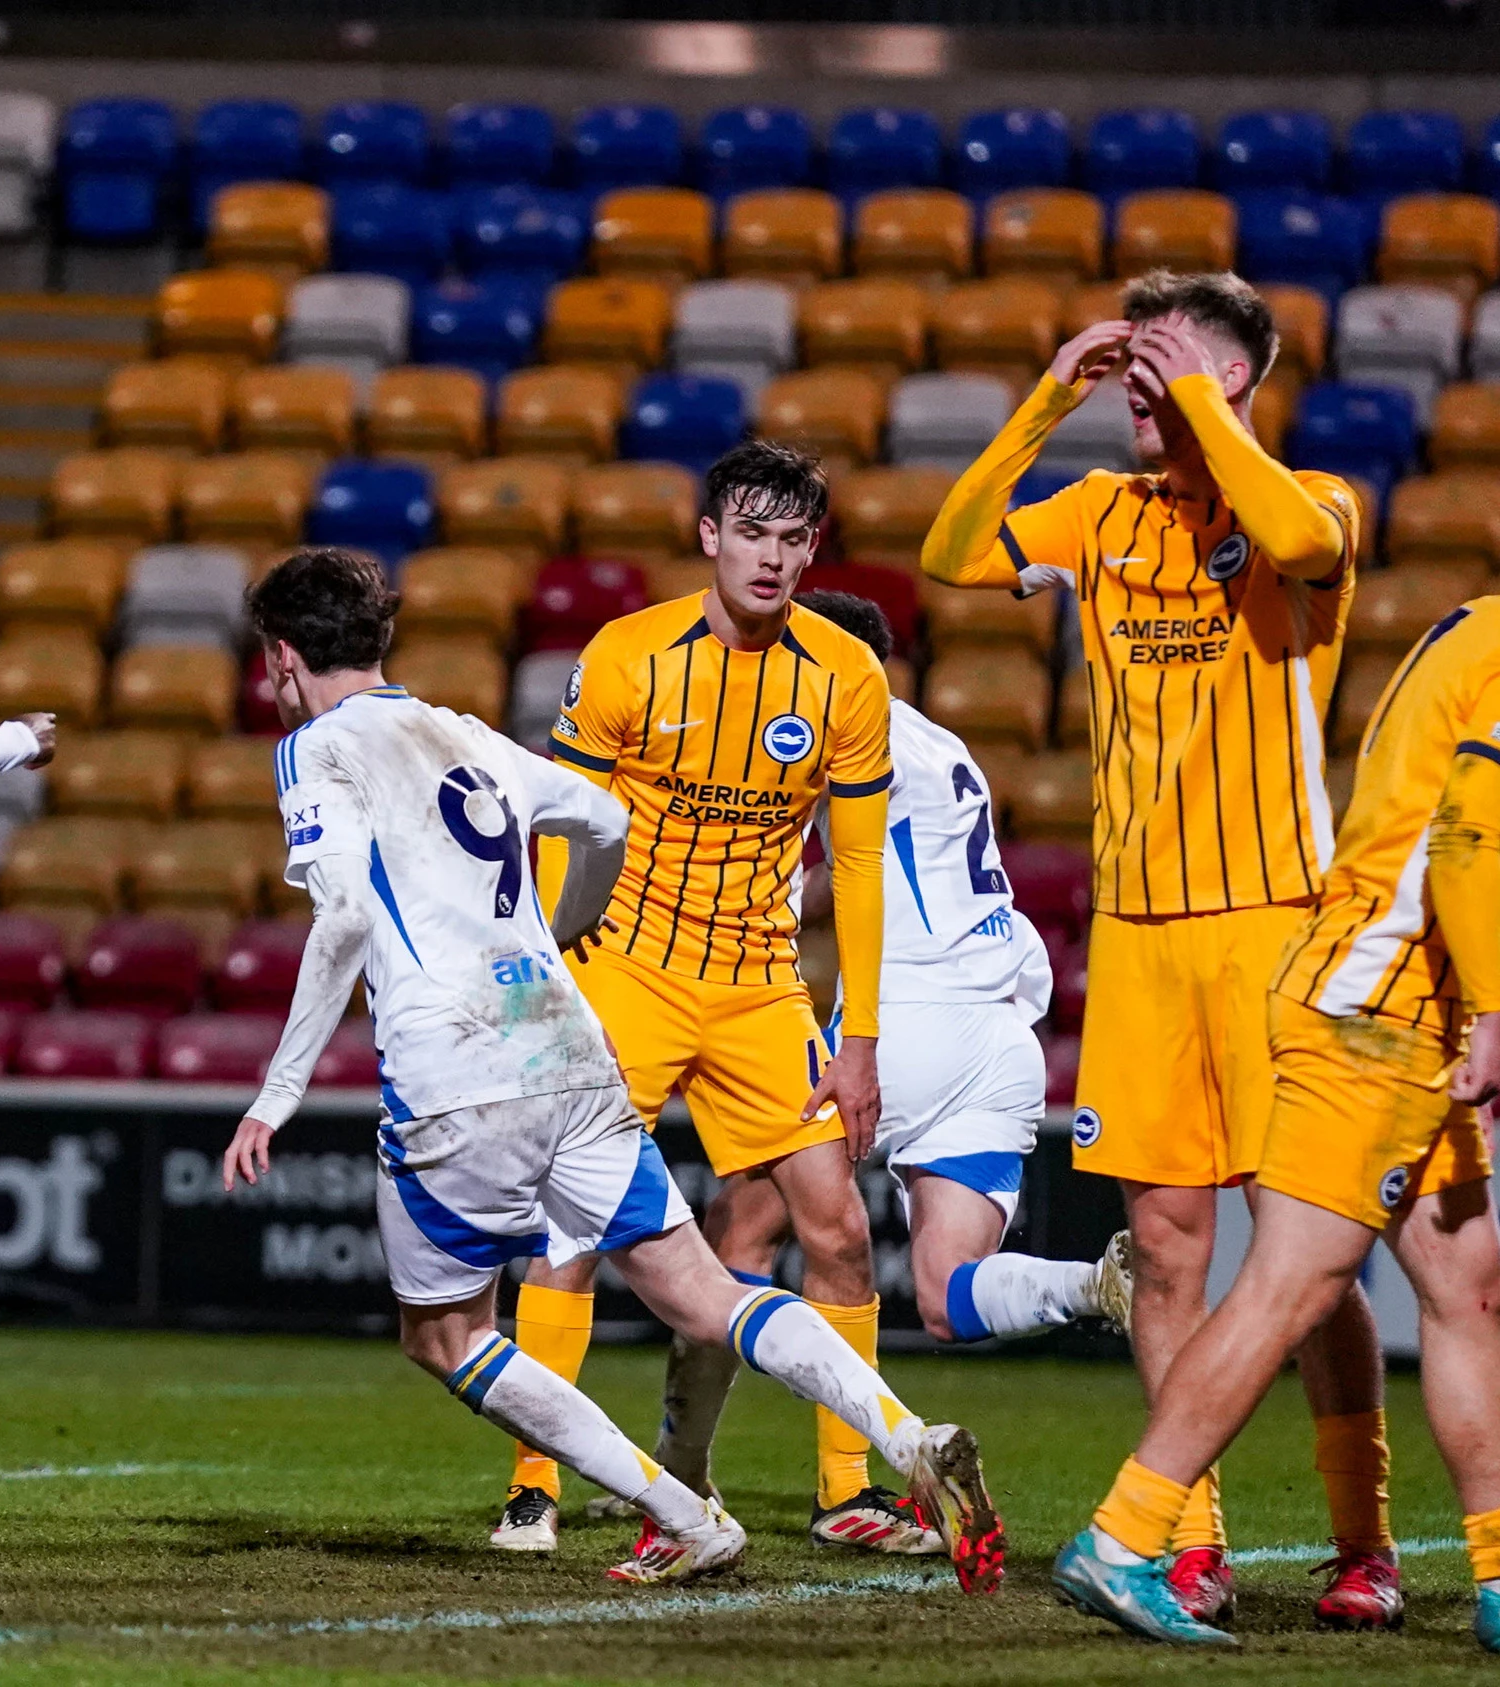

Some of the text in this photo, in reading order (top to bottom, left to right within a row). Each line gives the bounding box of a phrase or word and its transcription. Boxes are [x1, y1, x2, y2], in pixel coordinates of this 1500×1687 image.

[653, 774, 793, 808] AMERICAN
[666, 795, 790, 828] EXPRESS
[951, 762, 1010, 896] 2
[437, 765, 523, 919] 9
